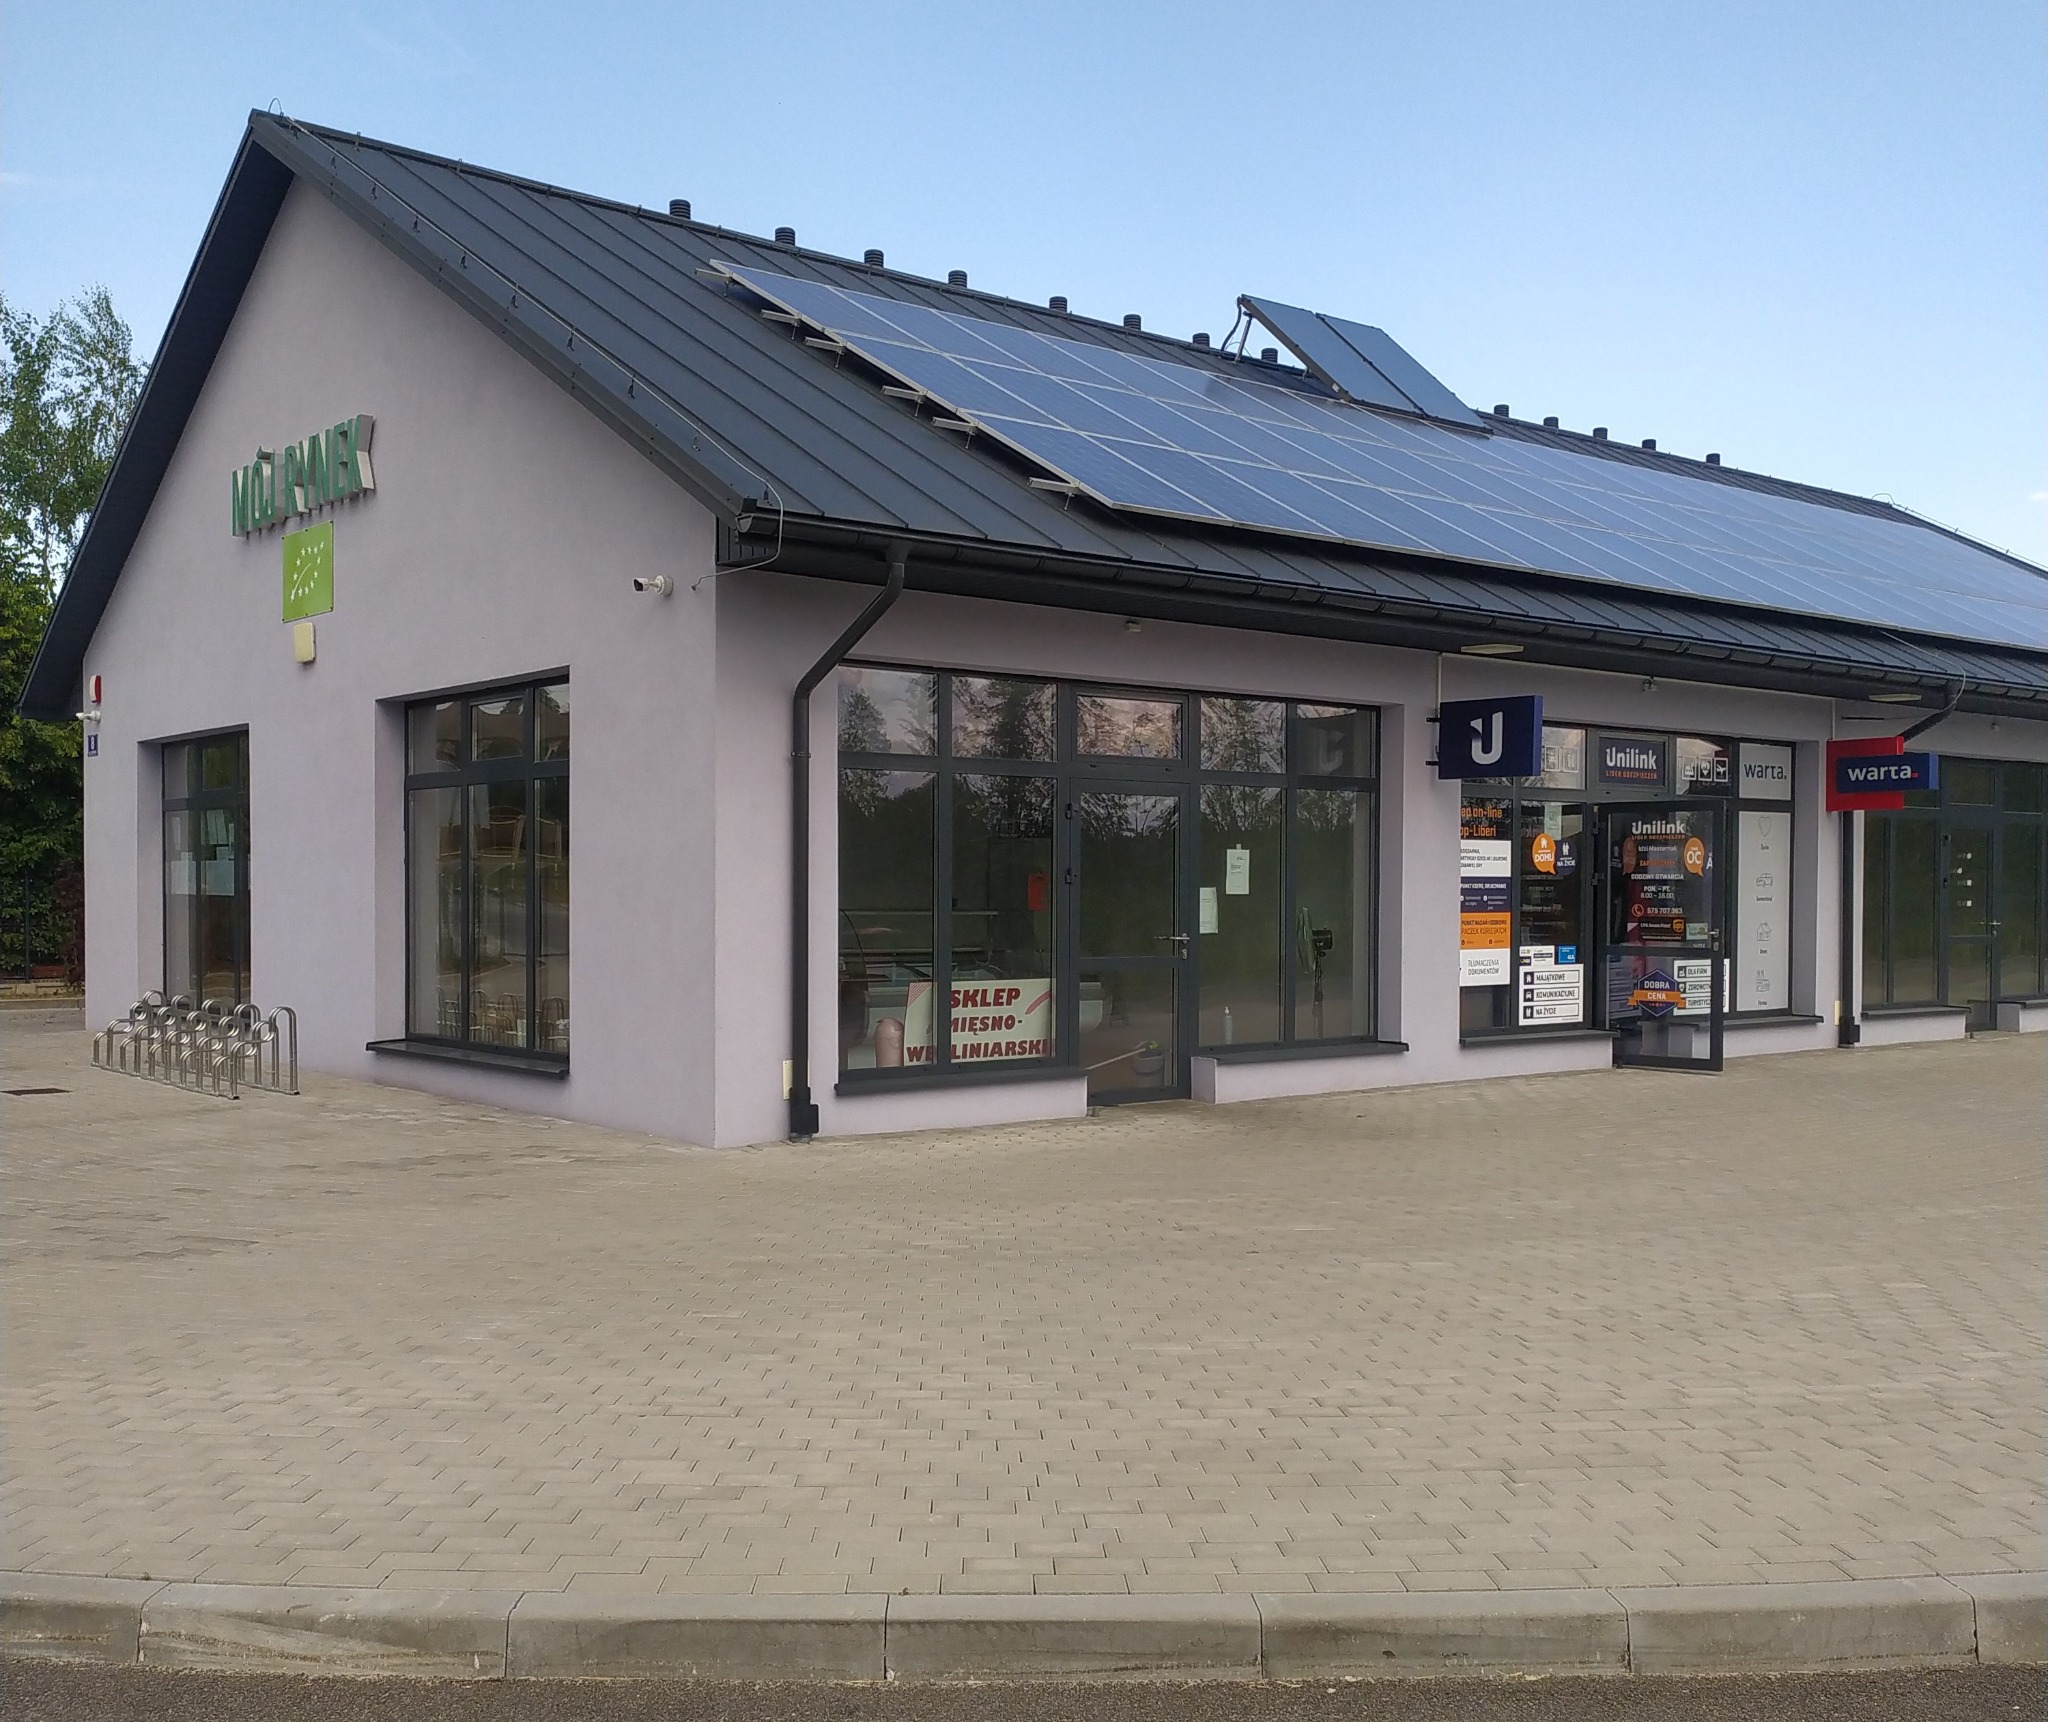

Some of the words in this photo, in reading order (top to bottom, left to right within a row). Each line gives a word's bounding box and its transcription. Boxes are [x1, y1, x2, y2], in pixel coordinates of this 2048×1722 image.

[231, 445, 277, 538] MÓJ
[284, 413, 375, 517] RYNEK
[90, 736, 95, 750] 8
[1605, 746, 1657, 770] Unilink
[1631, 820, 1686, 834] Unilink
[1534, 853, 1555, 863] DOMU
[1686, 850, 1703, 865] OC
[1535, 973, 1566, 983] MAJĄTKOWE
[1644, 981, 1671, 990] DOBRA
[951, 988, 1021, 1008] SKLEP
[1535, 989, 1576, 999] KOMUNIKACYJNE
[1647, 992, 1667, 1000] CENA
[906, 1039, 1050, 1062] WLINIARSKI
